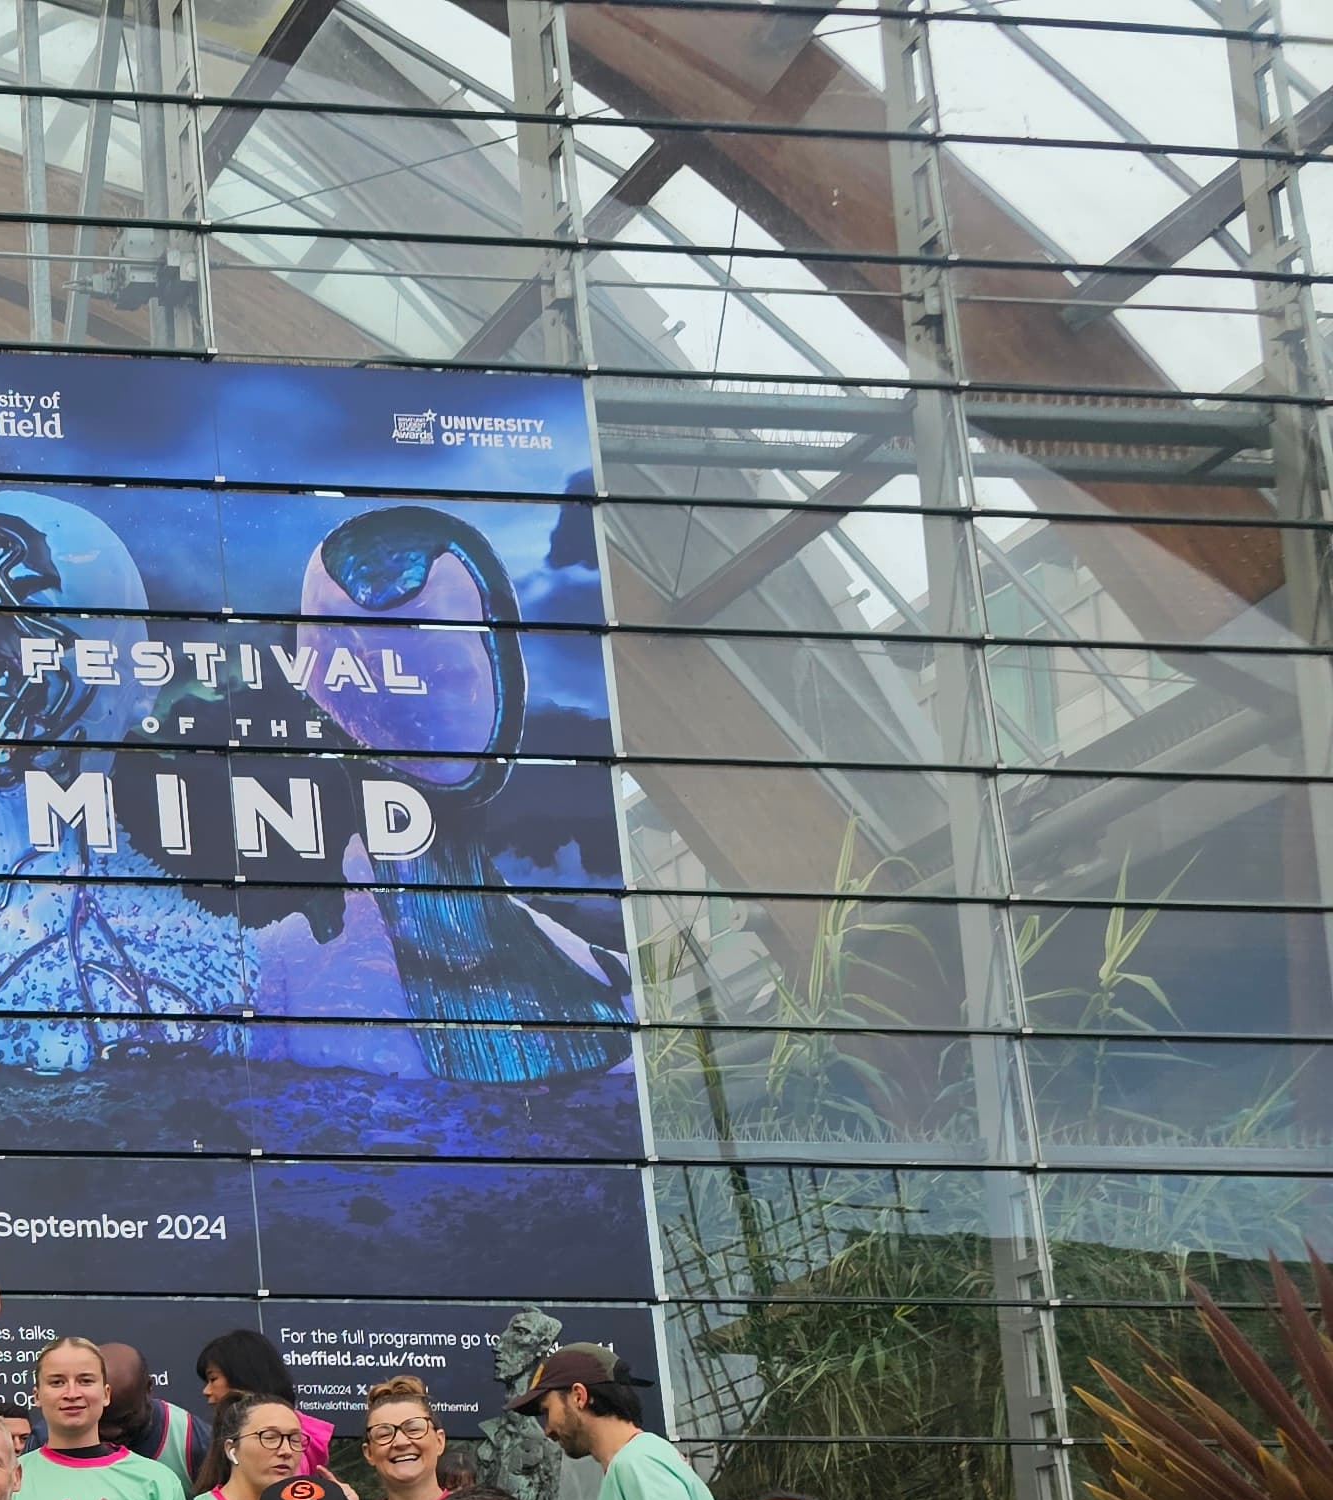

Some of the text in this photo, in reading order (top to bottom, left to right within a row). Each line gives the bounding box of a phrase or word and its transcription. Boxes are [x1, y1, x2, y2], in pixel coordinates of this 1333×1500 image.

[39, 391, 61, 409] of
[440, 415, 545, 433] UNIVERSITY
[441, 432, 553, 449] OF THE YEAR
[20, 637, 427, 695] FESTIVAL
[141, 716, 324, 739] OF THE
[23, 769, 437, 861] MIND
[155, 1214, 228, 1240] 2024
[281, 1328, 305, 1344] For
[311, 1329, 337, 1344] the
[341, 1329, 365, 1346] full
[369, 1333, 457, 1349] programme
[460, 1335, 481, 1350] go
[282, 1351, 446, 1369] sheffield.ac.uk/fotm
